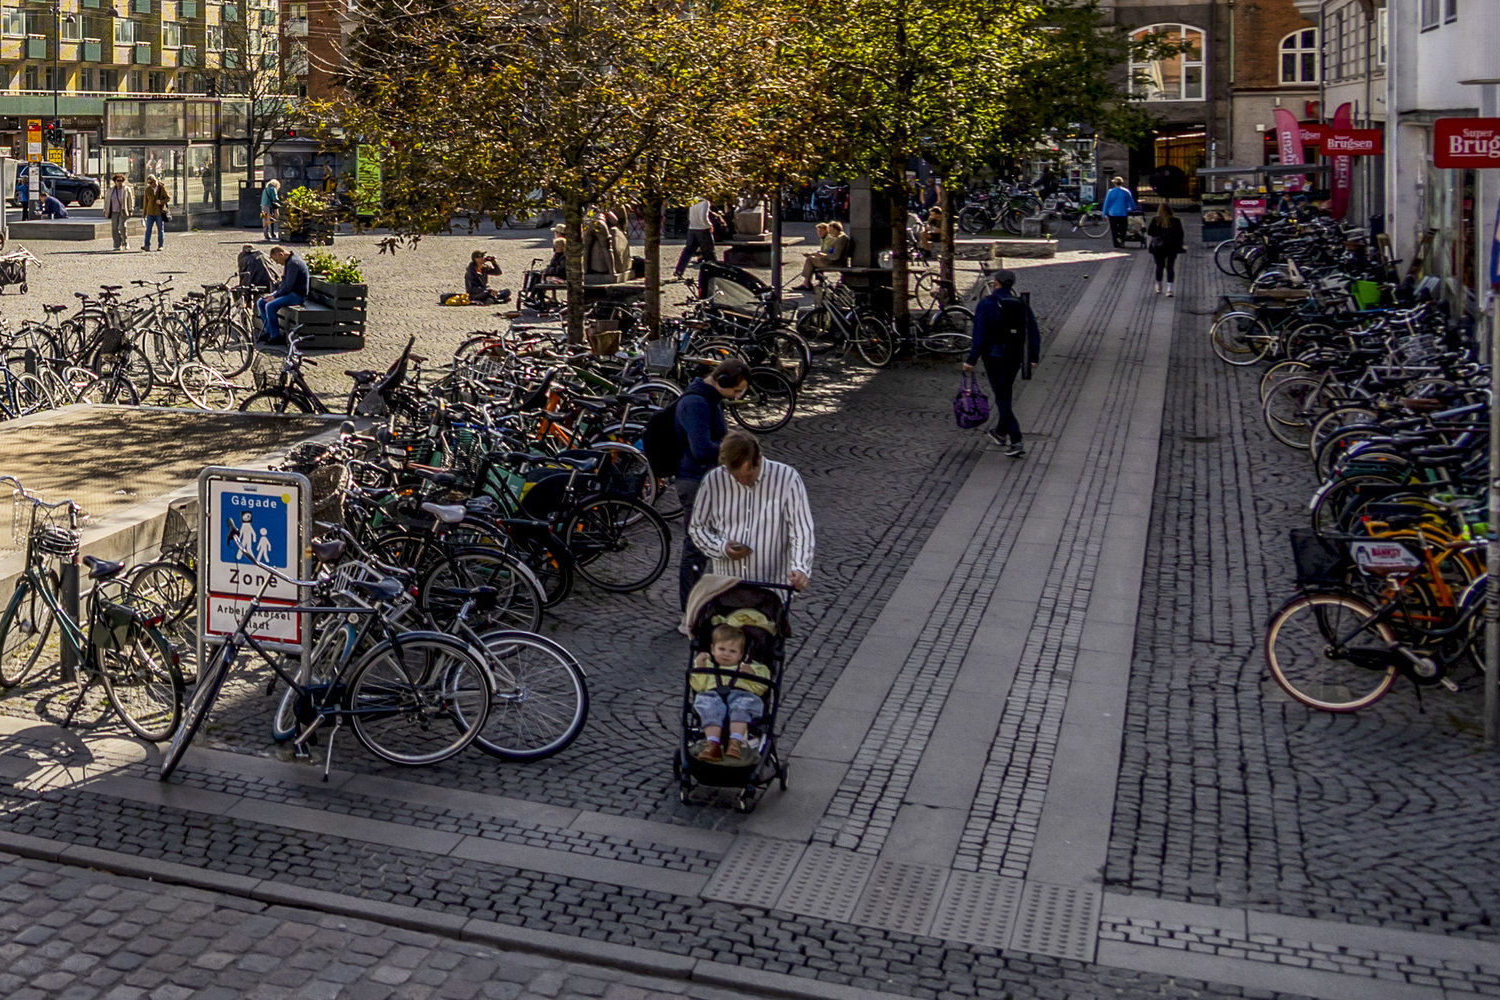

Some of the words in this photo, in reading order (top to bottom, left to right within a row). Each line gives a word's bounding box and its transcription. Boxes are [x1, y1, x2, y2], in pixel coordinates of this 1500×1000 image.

[1463, 128, 1494, 140] Super
[1327, 138, 1373, 151] Brugsen
[1449, 135, 1500, 158] Brug
[231, 495, 278, 509] Gågade
[229, 568, 278, 588] Zone
[217, 604, 291, 621] Arbejskørsel
